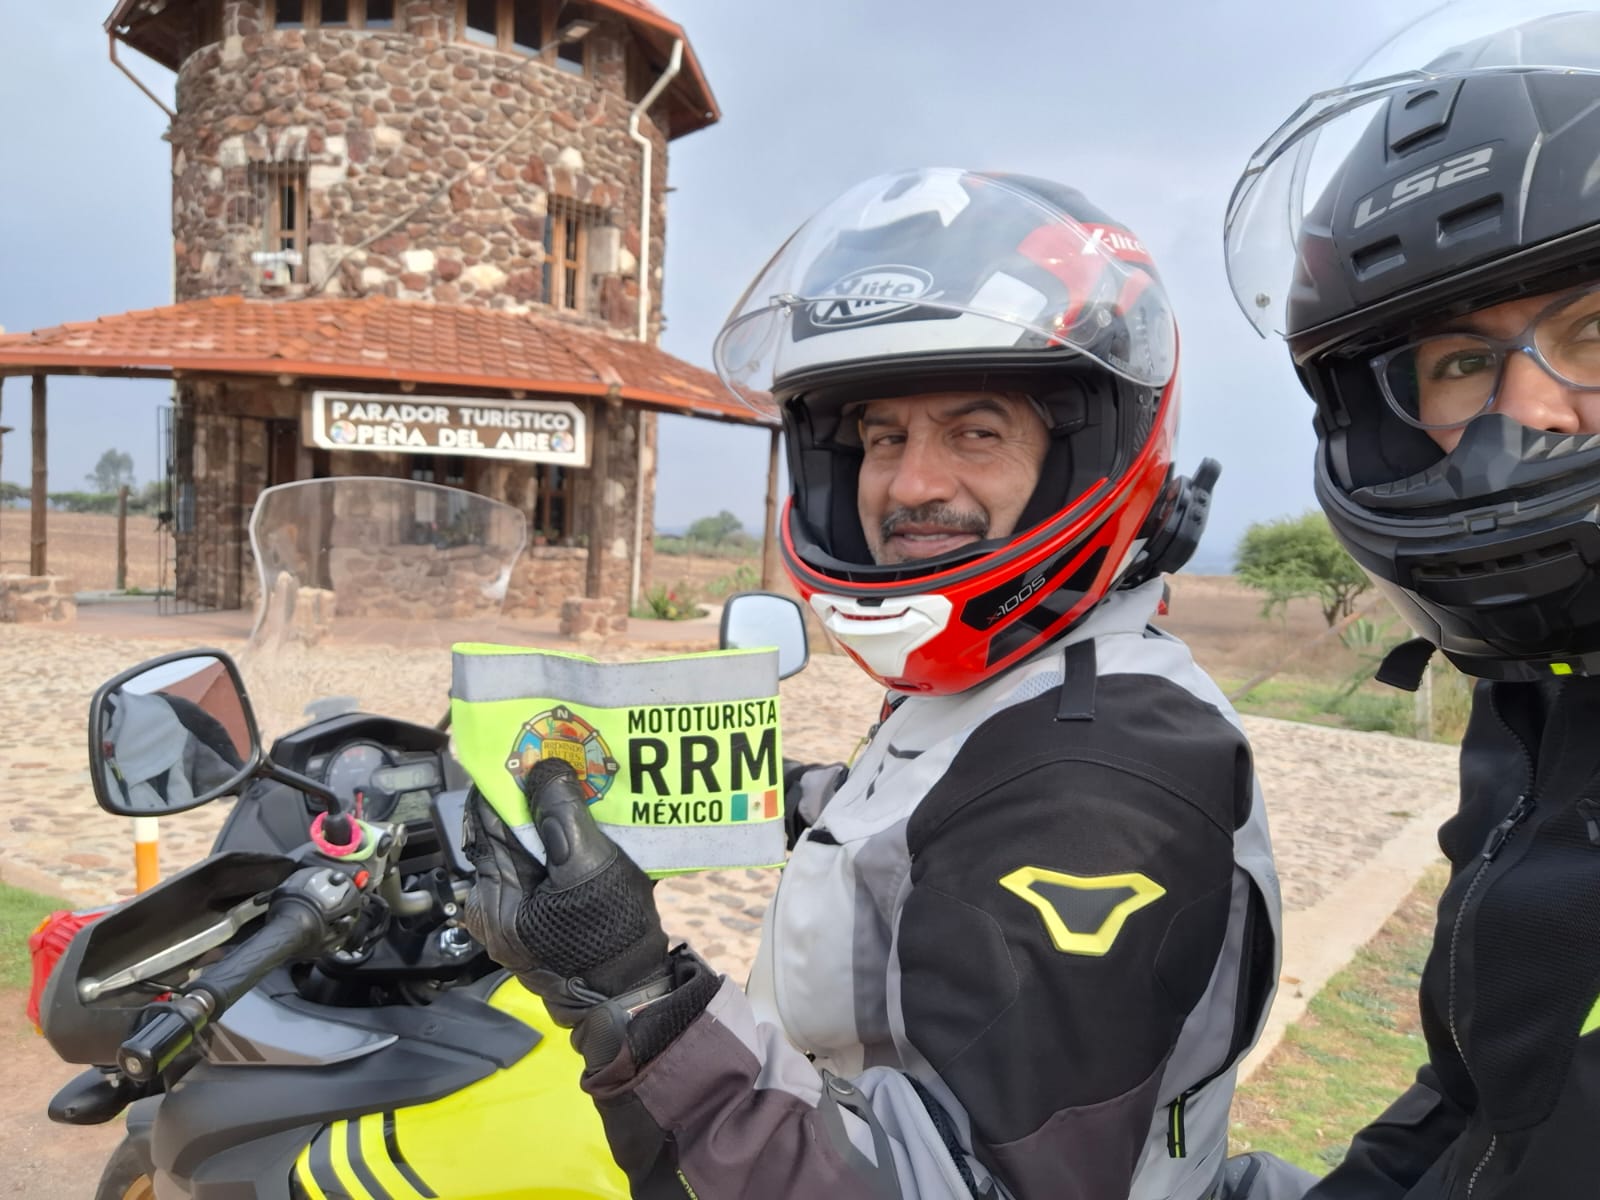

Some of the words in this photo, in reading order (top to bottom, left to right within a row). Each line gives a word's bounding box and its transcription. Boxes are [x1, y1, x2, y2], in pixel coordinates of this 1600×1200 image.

[1354, 148, 1493, 229] LS2
[333, 401, 448, 425] PARADOR
[460, 408, 570, 430] TURÍSTICO
[356, 422, 427, 446] PEÑA
[438, 429, 485, 449] DEL
[496, 433, 550, 451] AIRE
[556, 709, 569, 719] N
[628, 700, 777, 734] MOTOTURISTA
[628, 727, 777, 796] RRM
[632, 799, 723, 824] MÉXICO
